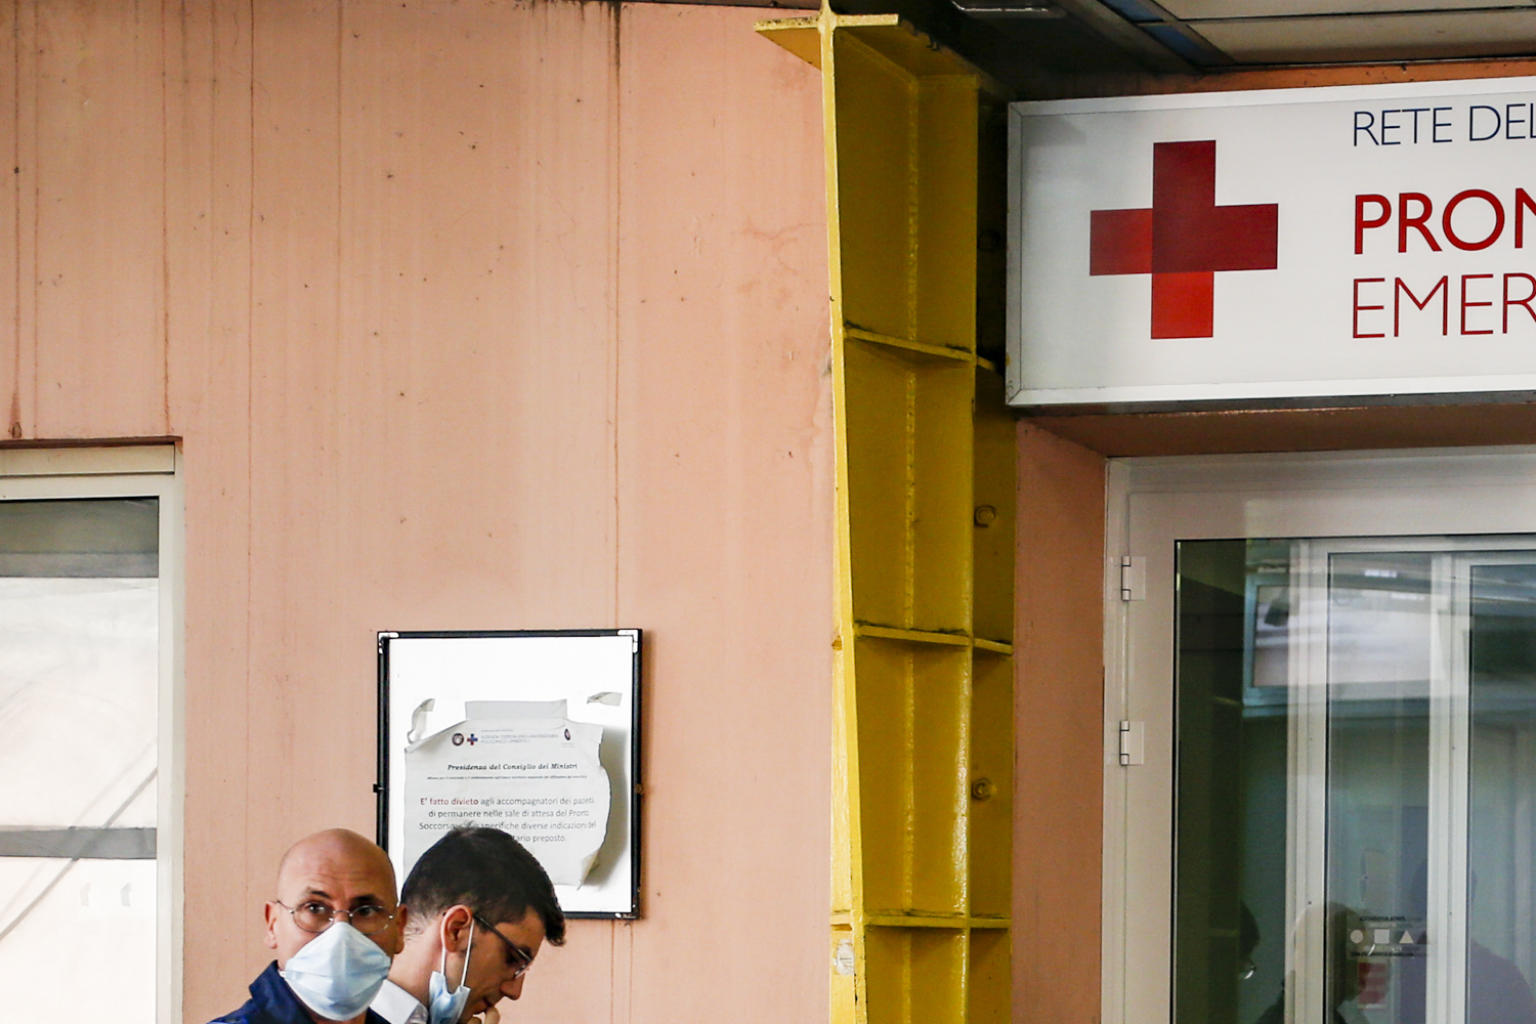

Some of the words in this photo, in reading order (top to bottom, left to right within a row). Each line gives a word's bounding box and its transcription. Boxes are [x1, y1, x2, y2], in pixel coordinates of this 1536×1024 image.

[1353, 106, 1453, 147] RETE
[502, 763, 536, 772] Consiglio
[429, 797, 449, 805] fatto
[451, 797, 479, 805] divieto
[480, 797, 495, 807] agli
[496, 797, 558, 807] accompagnatori
[428, 809, 436, 817] di
[437, 810, 481, 818] permanere
[483, 809, 503, 817] nelle
[504, 809, 520, 817] sale
[522, 809, 531, 817] di
[531, 809, 554, 817] attesa
[555, 809, 567, 817] del
[521, 821, 548, 830] diverse
